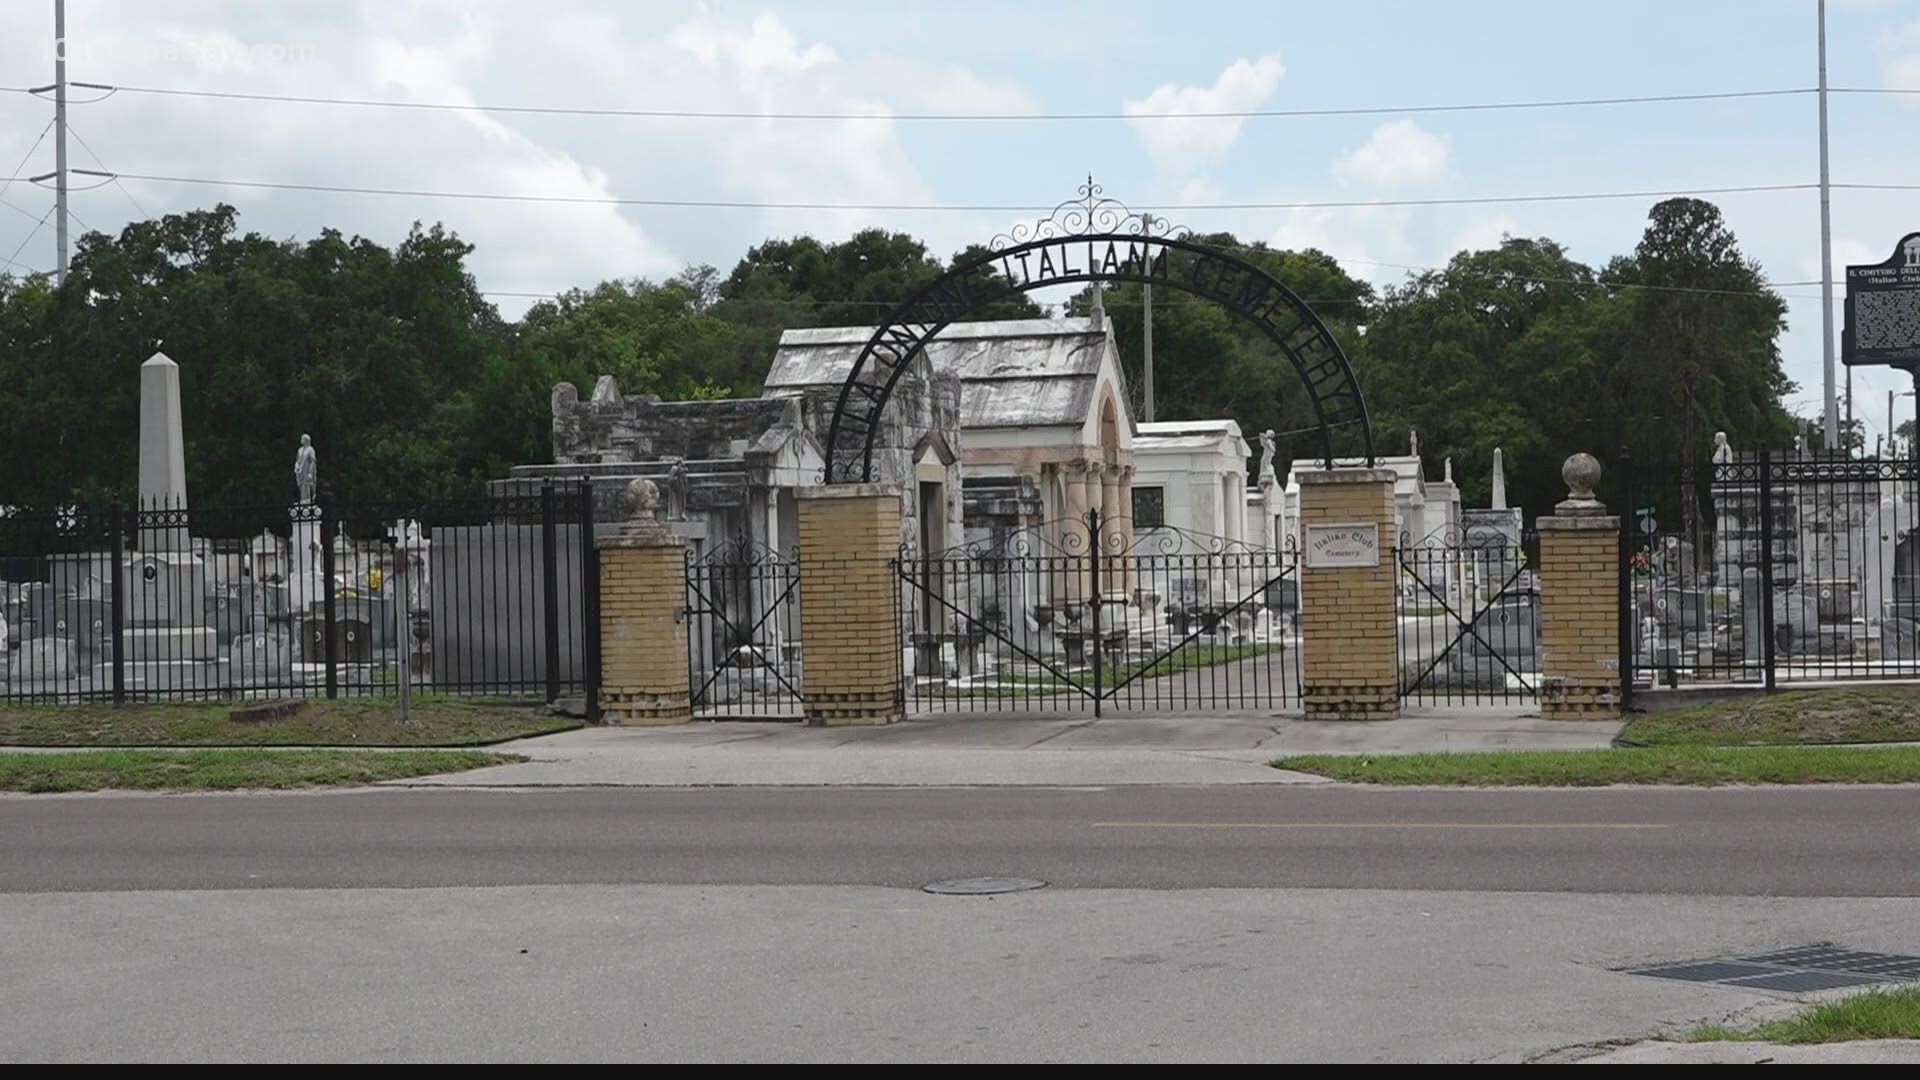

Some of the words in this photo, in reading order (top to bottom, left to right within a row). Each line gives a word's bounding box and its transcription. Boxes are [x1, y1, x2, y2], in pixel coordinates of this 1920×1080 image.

[1003, 239, 1168, 288] ITALIANA
[1193, 255, 1355, 402] CEMETERY
[1314, 533, 1347, 550] Italian
[1351, 532, 1373, 548] Club
